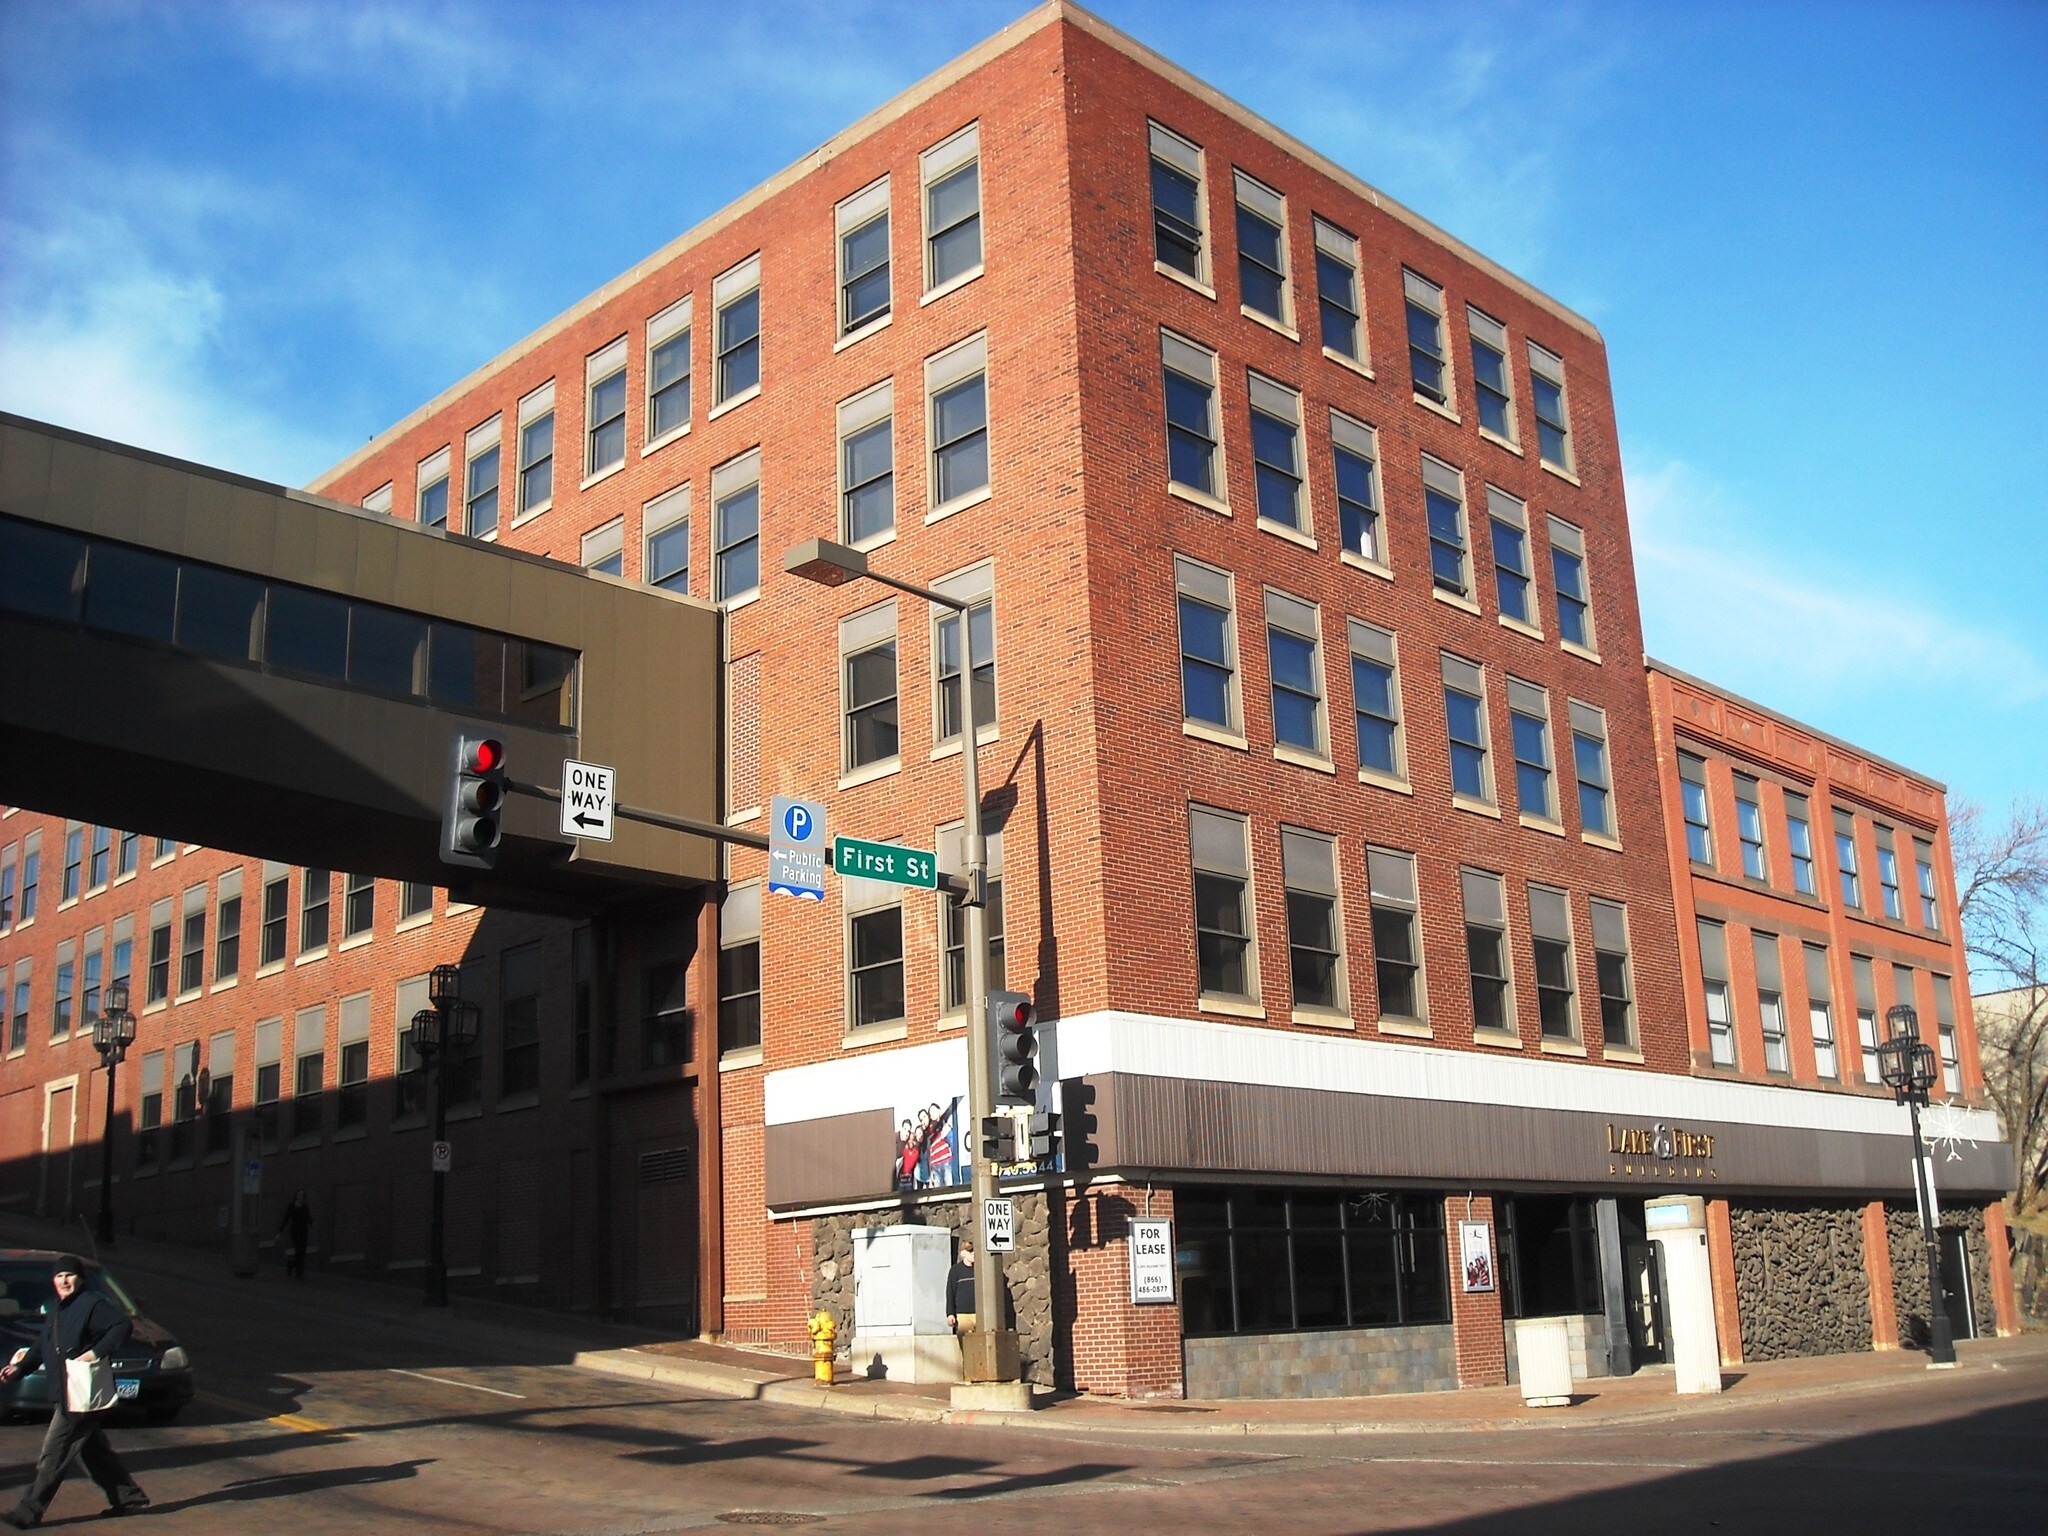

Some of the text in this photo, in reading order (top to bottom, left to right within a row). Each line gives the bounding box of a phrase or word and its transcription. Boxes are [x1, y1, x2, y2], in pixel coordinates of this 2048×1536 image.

[572, 769, 607, 790] ONE
[571, 790, 606, 811] WAY
[789, 850, 822, 867] Public
[843, 846, 929, 879] First St
[782, 865, 822, 888] Parking
[987, 1203, 1010, 1216] ONE
[987, 1218, 1010, 1230] WAY
[1140, 1228, 1160, 1239] FOR
[1136, 1244, 1166, 1255] LEASE
